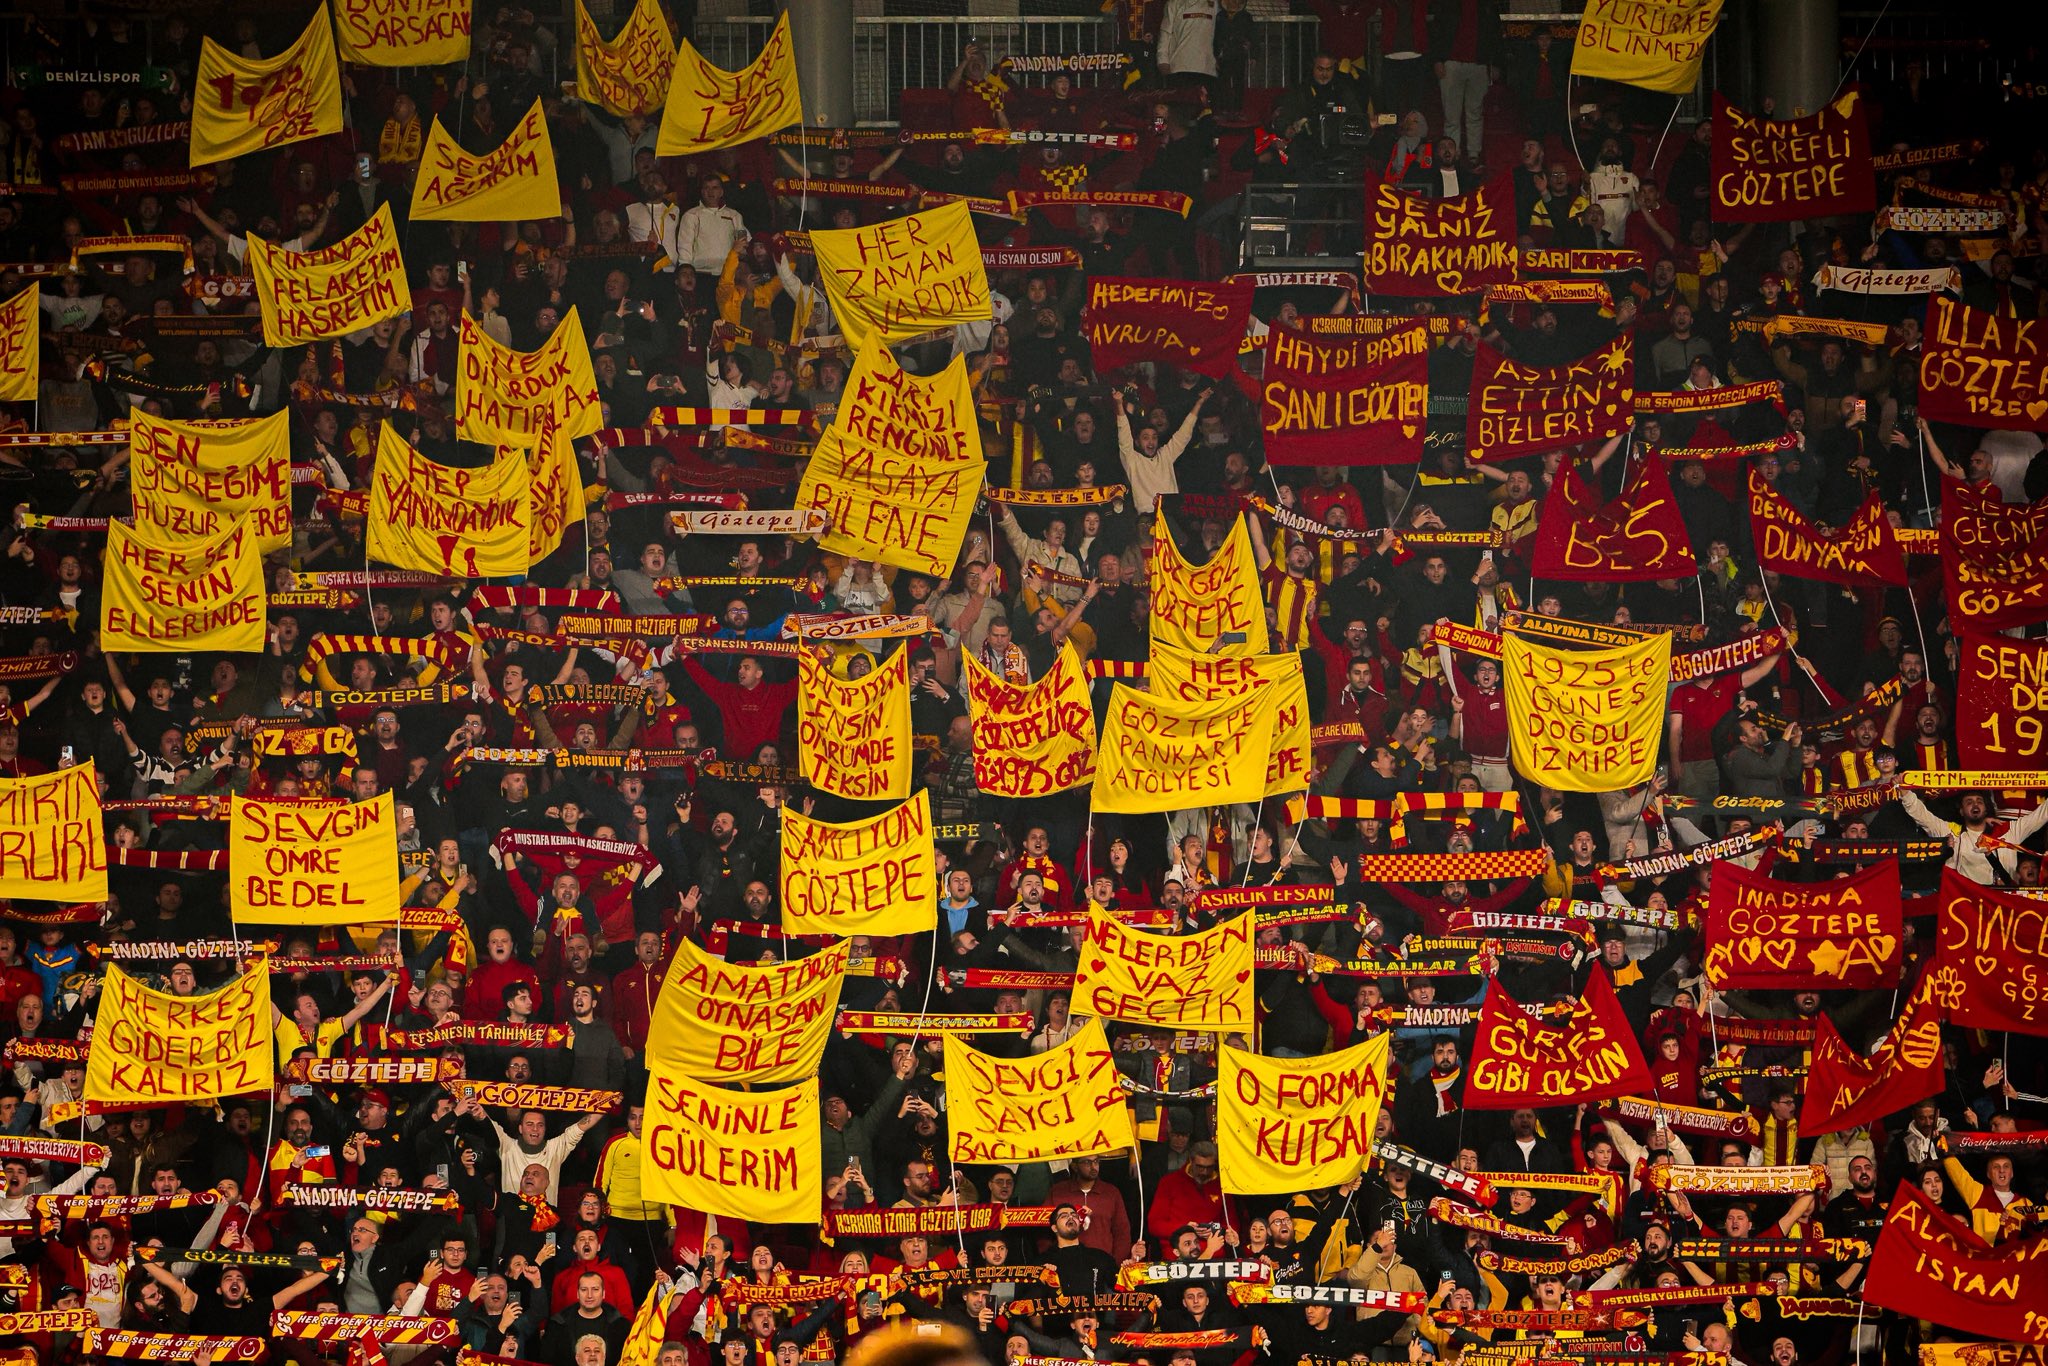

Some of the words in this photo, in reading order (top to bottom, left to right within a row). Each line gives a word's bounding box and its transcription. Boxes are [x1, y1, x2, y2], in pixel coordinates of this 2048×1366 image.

[350, 11, 471, 50] SARSACAK
[1069, 53, 1124, 71] GÖZTEPE
[46, 69, 141, 83] DENİZLİSPOR
[1011, 130, 1119, 146] GÖZTEPE
[1731, 130, 1852, 169] ŞEREFLİ
[828, 180, 863, 196] DÜNYAYI
[865, 182, 906, 199] SARSACAK
[1044, 191, 1093, 203] FORZA
[1097, 193, 1155, 205] GÖZTEPE
[1718, 163, 1846, 208] GÖZTEPE
[1893, 209, 2006, 228] GÖZTEPE
[857, 217, 923, 265] HER
[835, 243, 954, 300] ZAMAN
[998, 252, 1027, 265] İSYAN
[1029, 254, 1061, 265] OLSUN
[1525, 251, 1570, 269] SARI
[274, 246, 401, 306] FELAKETİM
[1842, 270, 1932, 293] Göztepe
[279, 278, 398, 338] HASRETİM
[858, 271, 982, 335] VARDIK
[1092, 323, 1185, 350] AVRUPA
[1274, 332, 1359, 374] HAYDİ
[1966, 395, 2023, 417] 1925
[134, 423, 201, 465] SEN
[408, 447, 471, 500] HEP
[838, 440, 963, 515] YASAYA
[53, 516, 84, 528] MUSTAFA
[133, 492, 220, 537] HUZUR
[700, 512, 794, 530] Göztepe
[1272, 504, 1329, 538] İNADINA
[1436, 531, 1491, 545] GÖZTEPE
[122, 540, 193, 576] HER
[140, 566, 234, 608] SENİN
[271, 592, 327, 605] GÖZTEPE
[107, 596, 261, 638] ELLERİNDE
[603, 617, 633, 634] İZMİR
[635, 617, 677, 636] GÖZTEPE
[678, 619, 700, 636] VAR
[808, 613, 911, 639] GÖZTEPE
[1523, 619, 1590, 640] ALAYINA
[1191, 657, 1260, 687] HER
[1519, 653, 1656, 689] 1925'te
[330, 687, 434, 705] GÖZTEPE
[1121, 700, 1254, 739] GÖZTEPE
[1529, 712, 1629, 747] DOĞDU
[1120, 732, 1247, 766] PANKART
[572, 756, 622, 769] ÇOCUKLUK
[813, 753, 889, 797] TEKSİN
[1111, 762, 1232, 794] ATÖLYESİ
[1712, 794, 1786, 812] Göztepe
[514, 832, 550, 847] MUSTAFA
[551, 834, 585, 848] KEMAL'İN
[587, 837, 638, 856] ASKERLERİYİZ
[1626, 852, 1689, 880] İNADINA
[1693, 832, 1754, 863] GÖZTEPE
[248, 875, 365, 909] BEDEL
[786, 854, 925, 917] GÖZTEPE
[1200, 889, 1268, 907] ASIRLIK
[1472, 912, 1567, 932] GÖZTEPE
[1574, 902, 1675, 928] GÖZTEPE
[111, 938, 180, 960] İNADINA
[186, 938, 253, 959] GÖZTEPE
[1083, 914, 1248, 969] NELERDEN
[1425, 939, 1478, 951] ÇOCUKLUK
[1506, 941, 1557, 956] AŞKIMSIN
[1129, 963, 1213, 998] VAZ
[121, 974, 258, 1031] HERKES
[696, 993, 827, 1033] OYNASAN
[1403, 1003, 1471, 1027] İNADINA
[108, 1019, 202, 1069] GİDER
[409, 1026, 476, 1046] EFSANESİN
[478, 1023, 545, 1042] TARİHİNLE
[714, 1029, 806, 1072] BİLE
[110, 1060, 259, 1097] KALIRIZ
[313, 1060, 433, 1081] GÖZTEPE
[480, 1083, 590, 1112] GÖZTEPE
[1236, 1067, 1261, 1108] O
[1276, 1063, 1381, 1111] FORMA
[658, 1079, 803, 1136] SENİNLE
[974, 1091, 1076, 1134] SAYGI
[1620, 1100, 1652, 1120] MUSTAFA
[23, 1141, 80, 1160] ASKERLERİYİZ
[651, 1124, 798, 1193] GÜLERİM
[1532, 1174, 1600, 1188] GÖZTEPELİLER
[1672, 1173, 1809, 1190] GÖZTEPE
[64, 1198, 85, 1207] HER
[87, 1197, 124, 1208] ŞEYDEN
[109, 1206, 127, 1216] BİZ
[129, 1204, 155, 1215] SENİ
[291, 1185, 358, 1208] İNADINA
[364, 1186, 436, 1211] GÖZTEPE
[836, 1213, 882, 1234] KORKMA
[884, 1211, 917, 1233] İZMİR
[970, 1207, 992, 1227] VAR
[184, 1249, 292, 1268] GÖZTEPE
[1148, 1261, 1270, 1280] GÖZTEPE
[976, 1265, 1041, 1280] GÖZTEPE
[742, 1284, 785, 1298] FORZA
[1272, 1283, 1401, 1307] GÖZTEPE
[298, 1315, 319, 1325] HER
[321, 1316, 363, 1328] ŞEYDEN
[365, 1315, 385, 1328] ÖTE
[386, 1318, 428, 1331] SEVDİK
[1491, 1311, 1587, 1327] GÖZTEPE
[108, 1333, 130, 1344] HER
[132, 1335, 174, 1348] ŞEYDEN
[176, 1338, 197, 1348] ÖTE
[149, 1348, 167, 1358] BİZ
